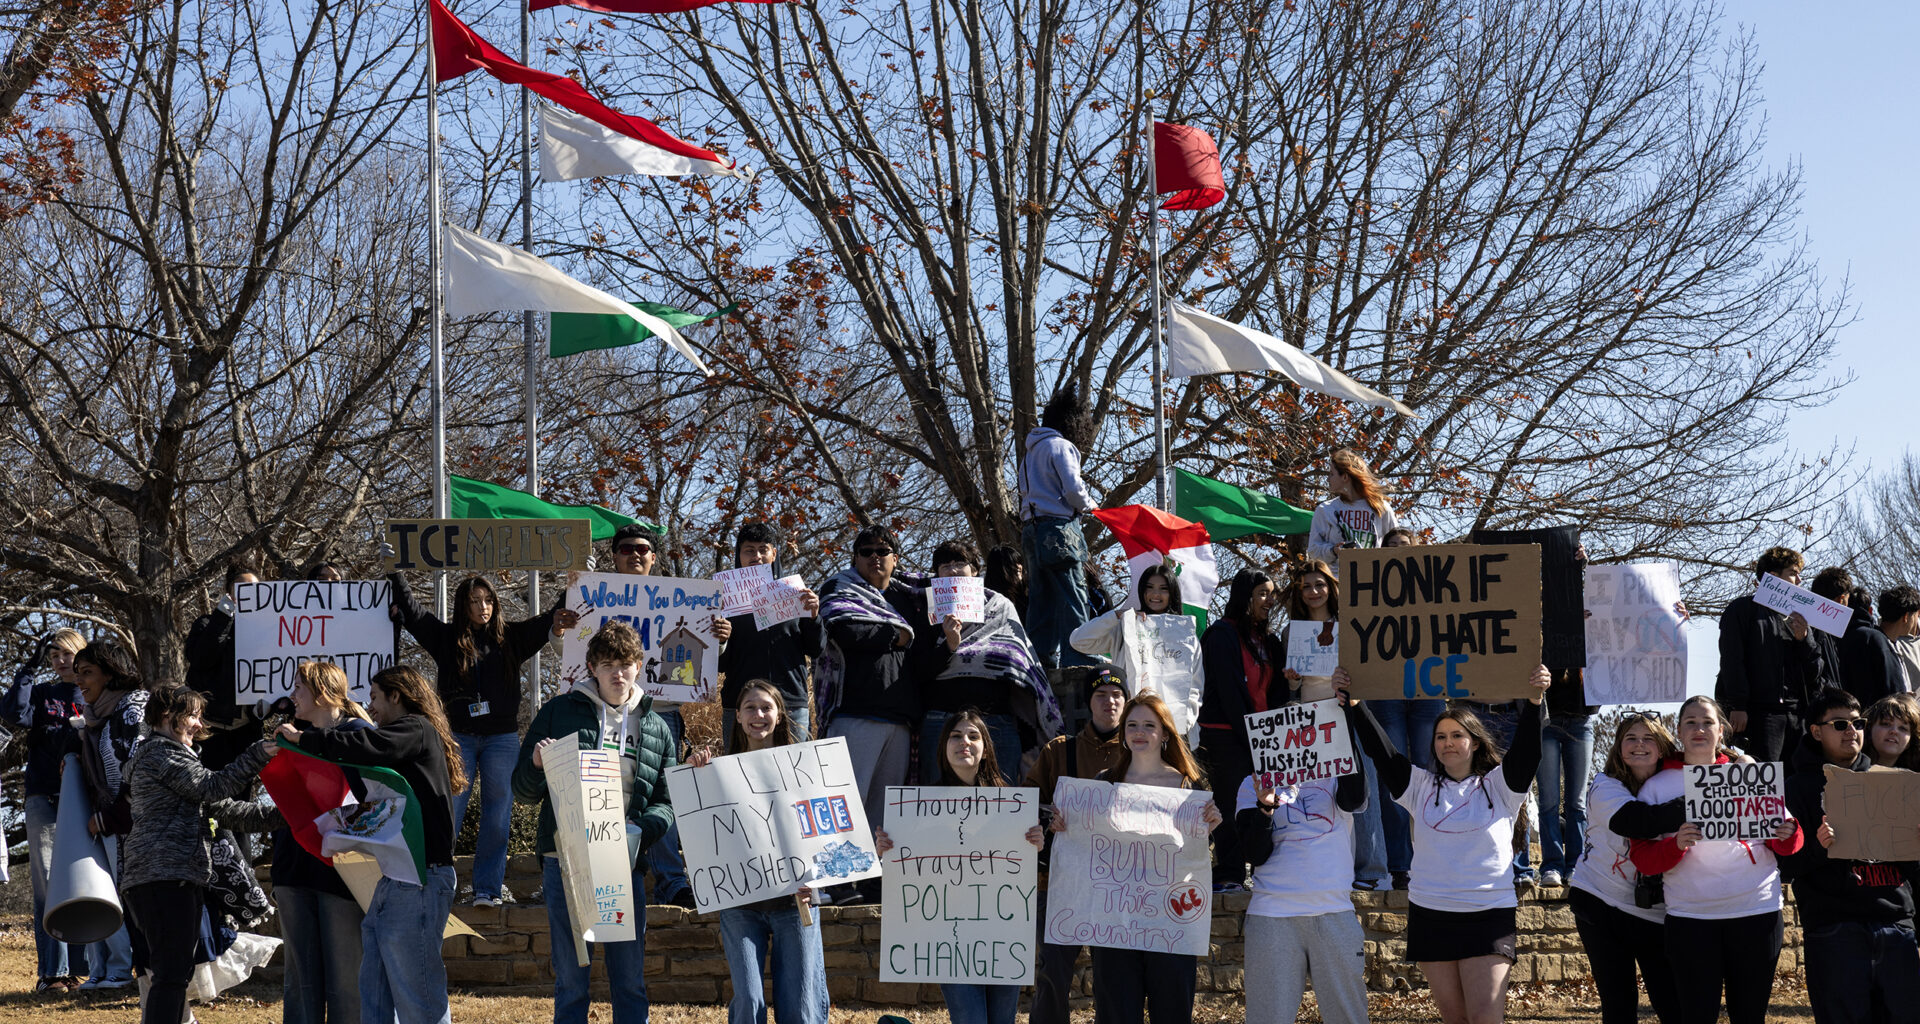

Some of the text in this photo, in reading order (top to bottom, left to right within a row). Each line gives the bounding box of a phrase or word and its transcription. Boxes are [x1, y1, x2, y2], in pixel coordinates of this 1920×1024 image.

[237, 580, 393, 613] EDUCATION
[580, 581, 722, 610] Would You Deport
[1349, 553, 1509, 607] HONK IF
[753, 596, 769, 608] OUR
[756, 608, 767, 616] TO
[1817, 602, 1844, 620] NOT
[278, 615, 334, 648] NOT
[1350, 615, 1421, 664] YOU
[1430, 609, 1517, 656] HATE
[1585, 655, 1685, 702] CRUSHED
[1251, 721, 1336, 751] DOES NOT
[1256, 749, 1318, 775] justify
[1261, 757, 1353, 789] BRUTALITY
[672, 742, 850, 817] I LIKE
[1702, 784, 1777, 799] CHILDREN
[888, 787, 1024, 821] Thoughts
[1732, 795, 1786, 818] TAKEN
[1842, 783, 1920, 820] FUCK
[713, 797, 852, 856] MY ICE
[1857, 823, 1917, 858] ICE
[899, 846, 1021, 886] Prayers
[1089, 834, 1182, 886] BUILT
[595, 884, 624, 897] MELT
[693, 853, 806, 907] CRUSHED
[597, 898, 617, 910] THE
[902, 884, 1036, 923] POLICY
[1093, 883, 1159, 918] This
[1170, 888, 1203, 917] ICE
[1049, 908, 1185, 953] Country
[889, 941, 1027, 980] CHANGES
